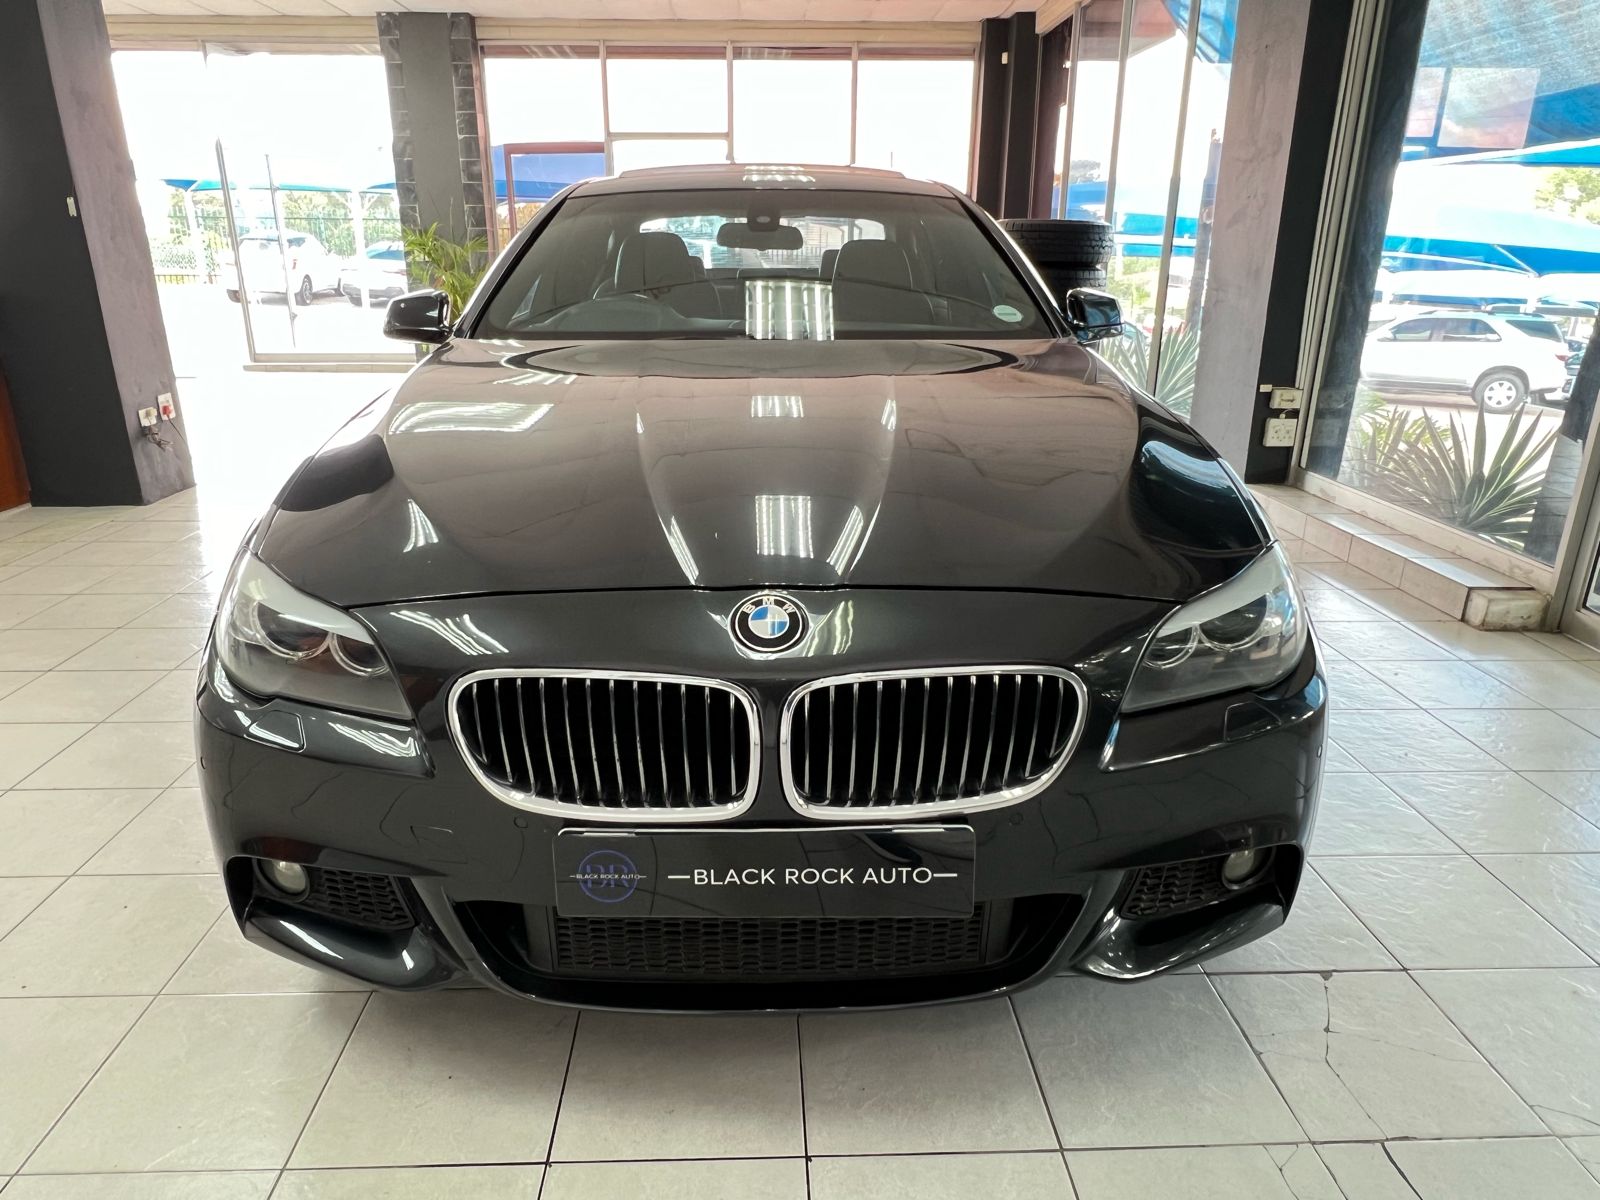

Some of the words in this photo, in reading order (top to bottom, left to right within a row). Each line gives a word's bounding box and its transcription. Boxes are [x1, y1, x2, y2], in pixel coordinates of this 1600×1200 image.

[742, 595, 796, 614] BMW
[693, 868, 776, 885] BLACK
[785, 867, 854, 885] ROCK
[862, 867, 932, 884] AUTO
